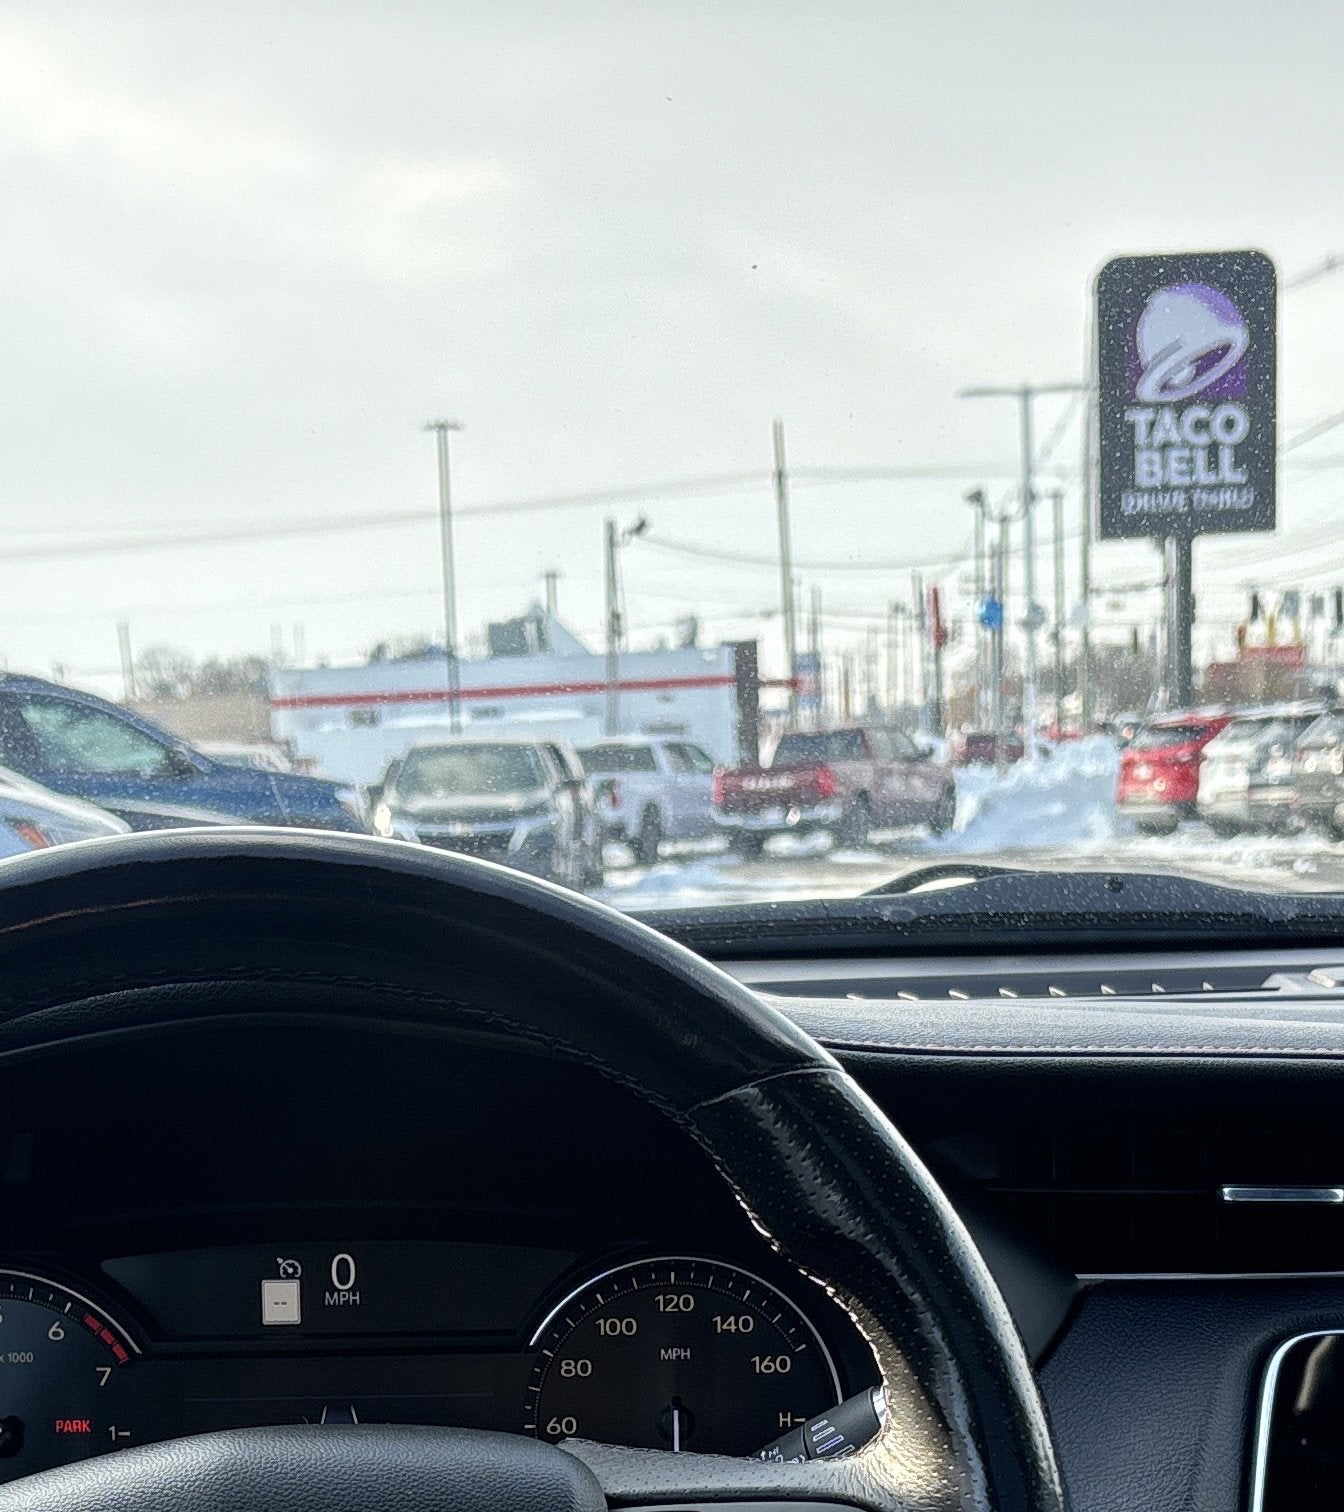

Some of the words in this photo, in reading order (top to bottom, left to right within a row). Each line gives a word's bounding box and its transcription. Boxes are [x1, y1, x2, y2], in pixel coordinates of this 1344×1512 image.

[1124, 403, 1250, 446] TACO
[1134, 445, 1248, 487] BELL
[330, 1253, 356, 1290] 0
[325, 1291, 360, 1306] MPH
[654, 1294, 694, 1312] 120
[48, 1321, 65, 1342] 6
[595, 1317, 637, 1337] 100
[712, 1314, 754, 1334] 140
[7, 1351, 34, 1363] 1000
[659, 1348, 691, 1362] MPH
[751, 1355, 791, 1374] 160
[95, 1366, 112, 1387] 7
[560, 1360, 592, 1379] 80
[55, 1419, 91, 1433] PARK
[546, 1416, 577, 1436] 60
[778, 1411, 792, 1428] H
